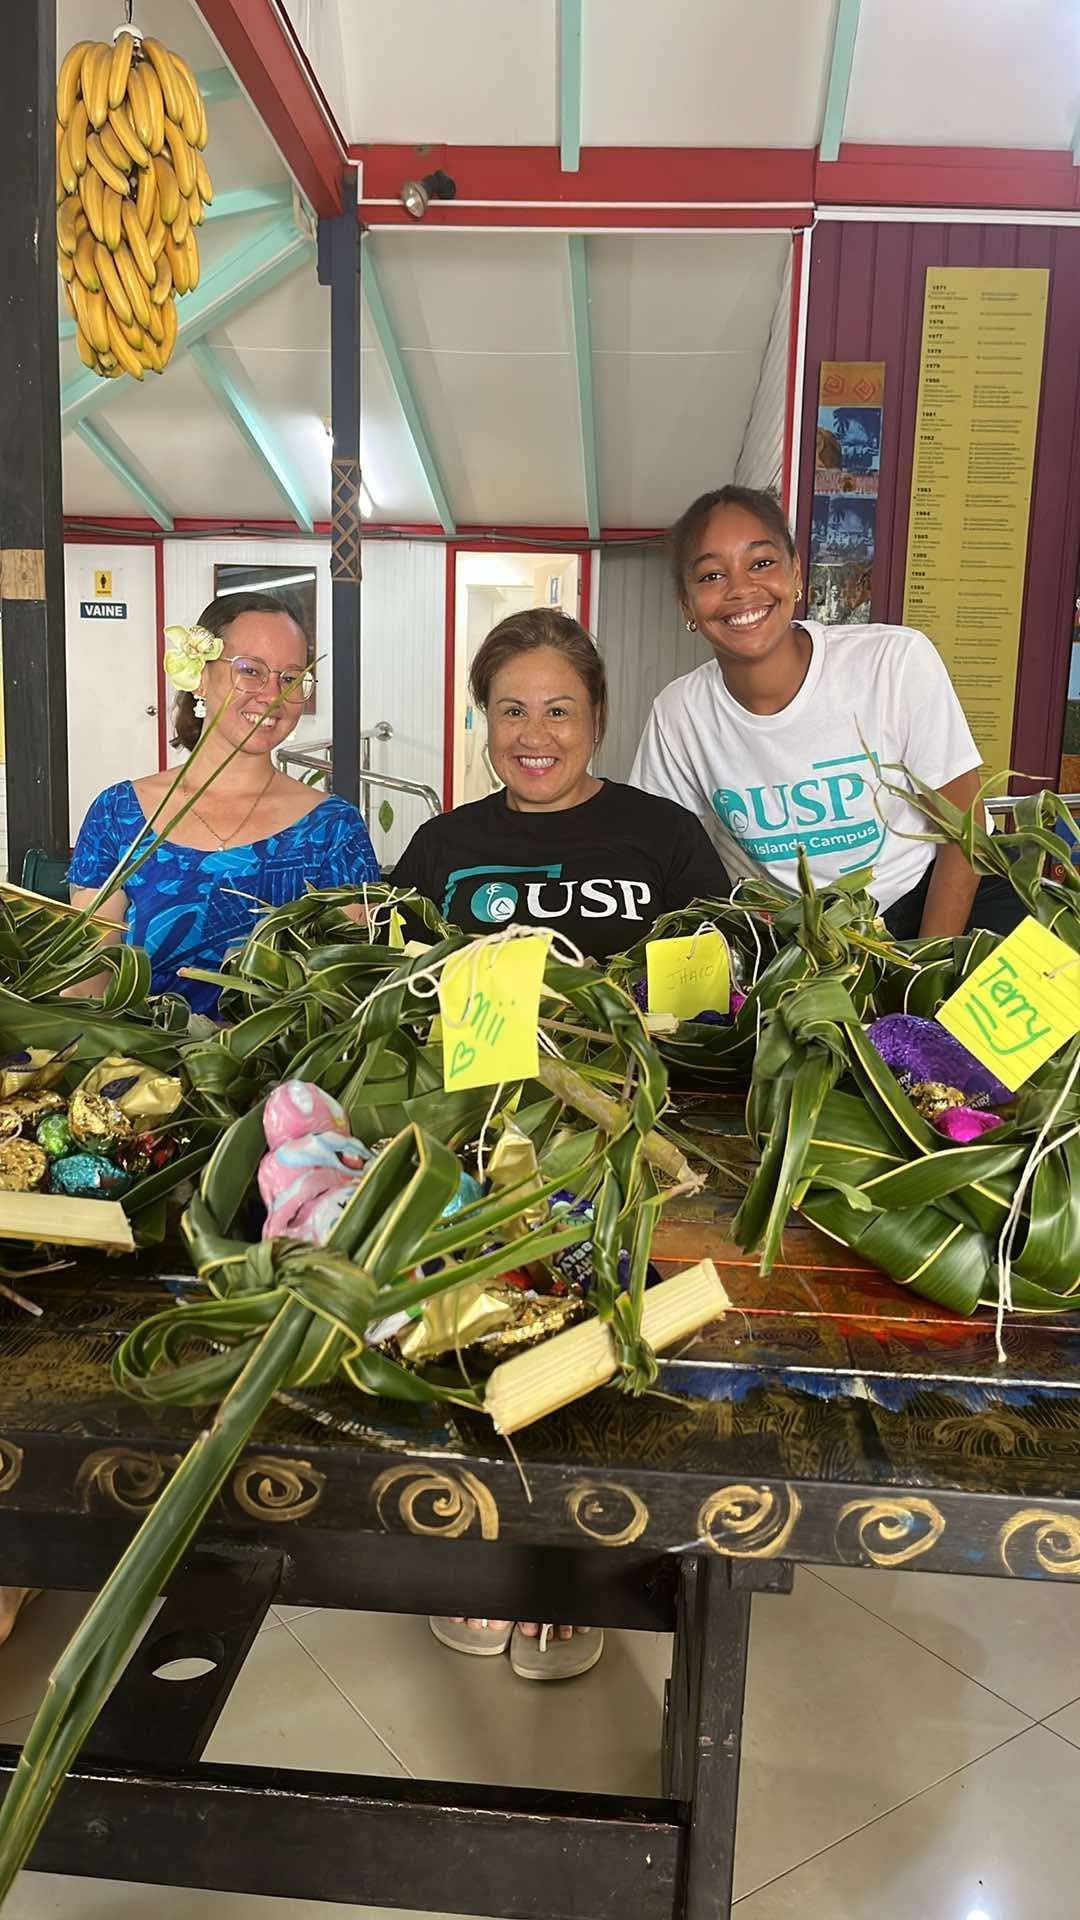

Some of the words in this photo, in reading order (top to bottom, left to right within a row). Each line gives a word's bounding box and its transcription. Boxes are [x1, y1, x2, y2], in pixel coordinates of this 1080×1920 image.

[84, 604, 123, 617] VAINE
[745, 772, 864, 831] USP
[755, 838, 807, 855] Islands
[809, 824, 876, 849] Campus
[524, 878, 651, 921] USP
[965, 956, 1052, 1056] Terry
